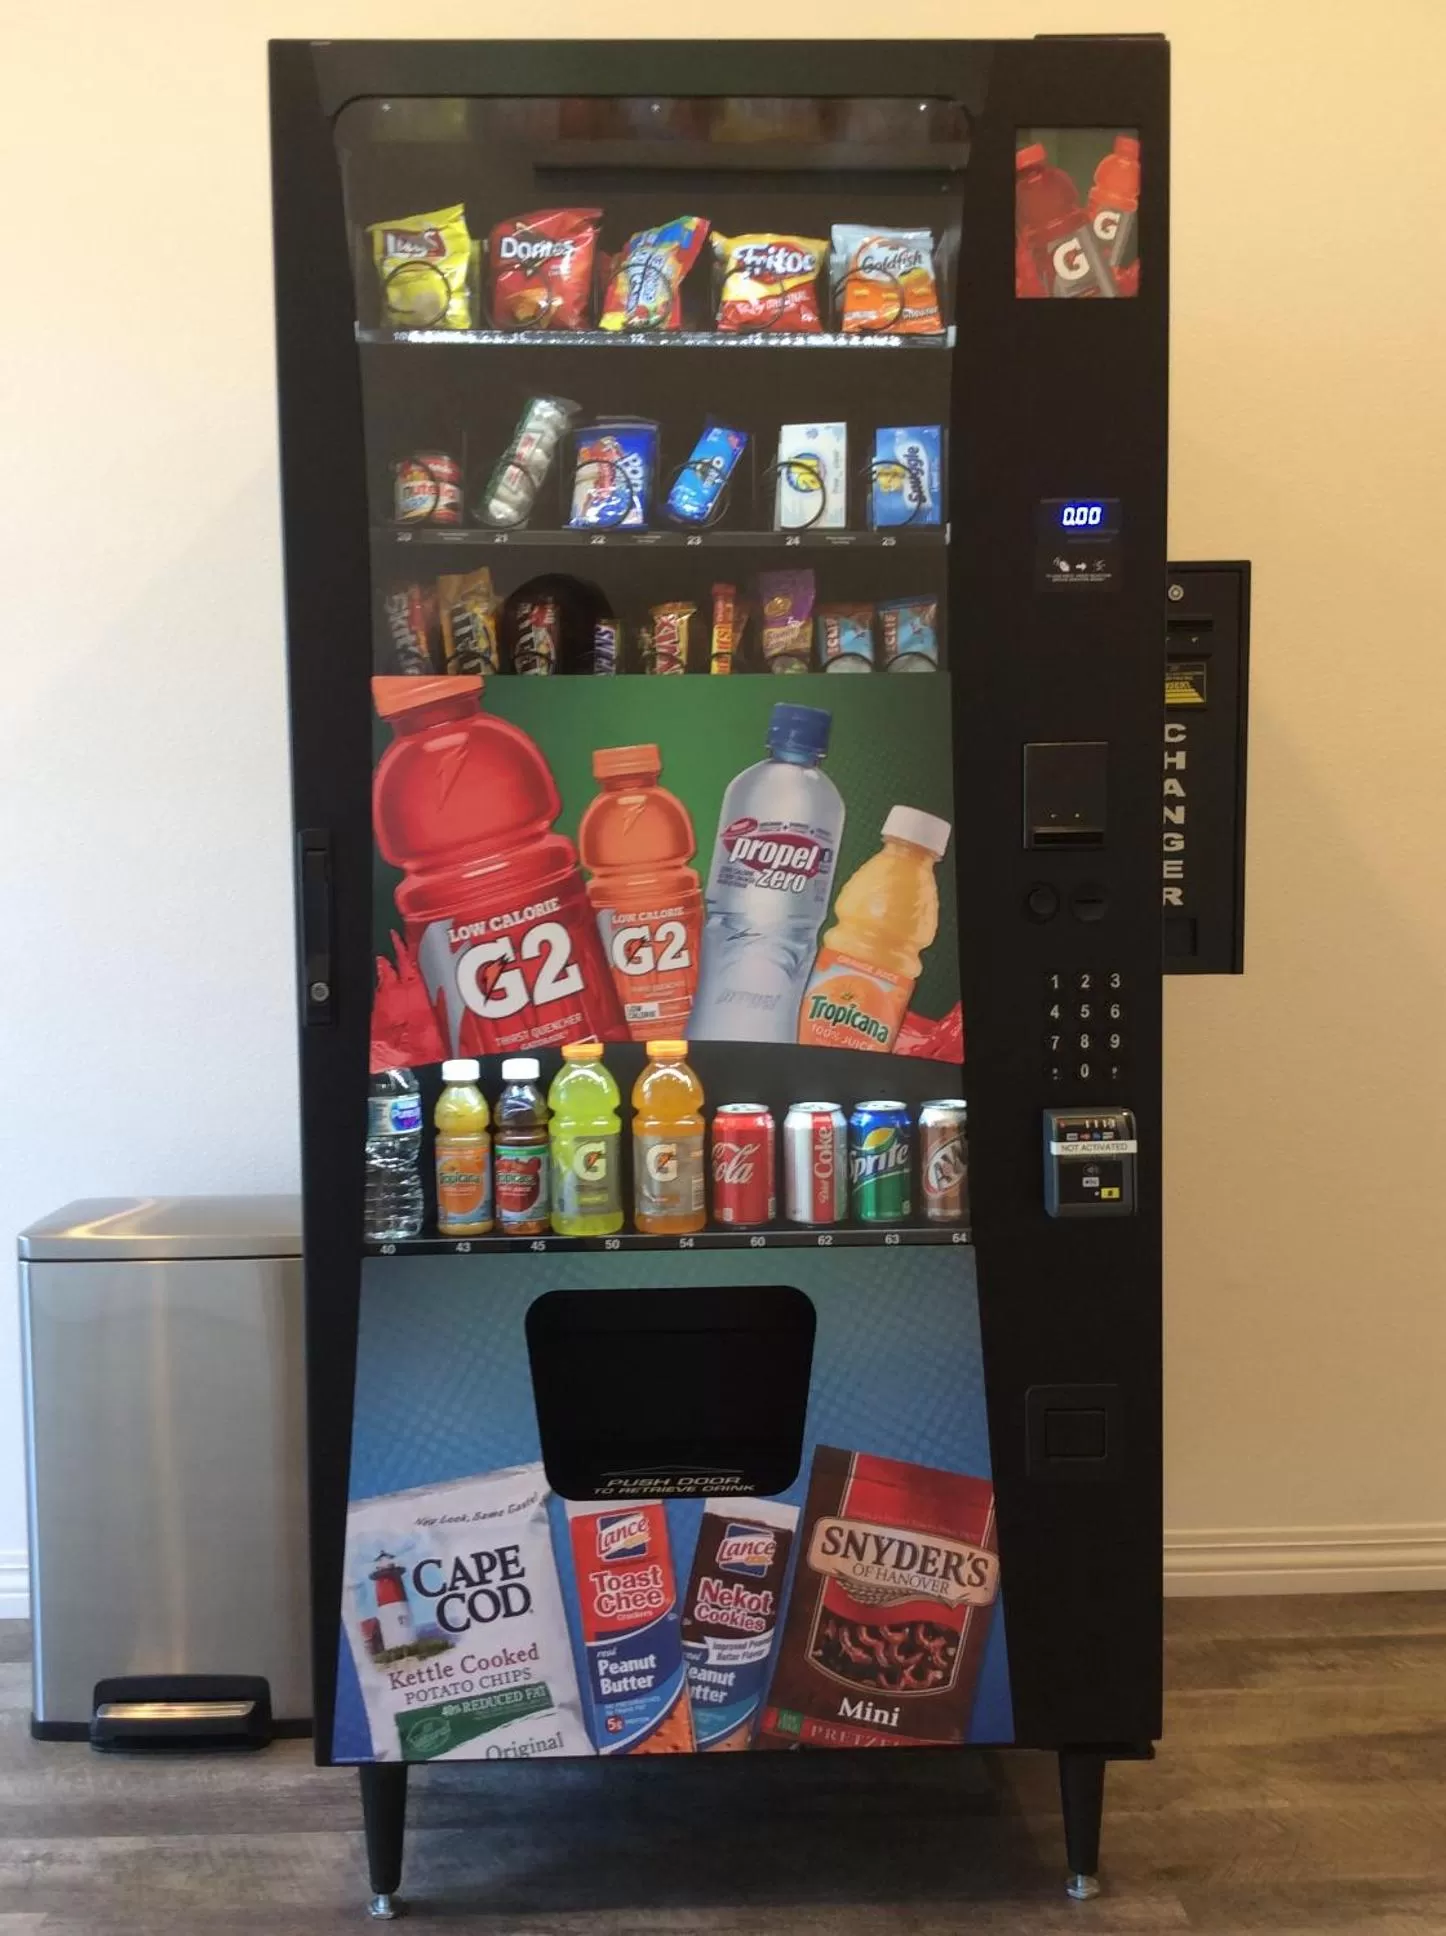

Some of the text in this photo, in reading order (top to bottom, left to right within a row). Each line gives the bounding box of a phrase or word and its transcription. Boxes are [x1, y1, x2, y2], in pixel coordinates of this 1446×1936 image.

[1093, 211, 1121, 240] G
[861, 249, 924, 273] Goldfish
[1053, 237, 1090, 281] G
[1162, 723, 1187, 906] CHANGER
[729, 835, 820, 870] propel
[756, 868, 807, 893] zero
[448, 897, 561, 943] LOW CALORIE
[612, 906, 684, 924] LOW CALORIE
[612, 920, 691, 976] G2
[456, 921, 585, 1019] G2
[1051, 973, 1121, 989] 1 2 3
[809, 994, 889, 1044] Tropicana
[1050, 1004, 1120, 1019] 4 5 6
[1051, 1033, 1120, 1050] 7 8 9
[1080, 1063, 1090, 1078] 0
[574, 1140, 607, 1181] G
[814, 1126, 834, 1179] Coke
[1061, 1143, 1128, 1153] NOT ACTIVATED
[646, 1143, 678, 1181] G
[456, 1242, 471, 1252] 43
[530, 1241, 546, 1251] 45
[605, 1239, 620, 1249] 50
[679, 1238, 694, 1248] 54
[751, 1236, 766, 1246] 60
[817, 1236, 833, 1246] 62
[885, 1234, 900, 1244] 63
[952, 1233, 967, 1243] 64
[593, 1483, 756, 1495] TO RETRIEVE DRINK
[607, 1476, 743, 1487] PUSH DOOR
[598, 1517, 649, 1556] Lance
[717, 1540, 776, 1564] Lance
[820, 1526, 989, 1588] SNYDER'S
[413, 1544, 526, 1598] CAPE
[590, 1566, 662, 1592] Toast
[852, 1562, 950, 1594] OF HANOVER
[436, 1582, 532, 1633] COD
[595, 1587, 664, 1618] Chee
[698, 1577, 773, 1615] Nekot
[694, 1605, 767, 1632] Cookies
[389, 1642, 541, 1690] Kettle Cooked
[597, 1654, 657, 1677] Peanut
[688, 1664, 736, 1687] eanut
[405, 1667, 533, 1706] POTATO CHIPS
[463, 1691, 524, 1712] REDUCED
[524, 1685, 547, 1700] FAT
[600, 1674, 655, 1696] Butter
[838, 1697, 900, 1727] Mini
[485, 1731, 565, 1759] Original
